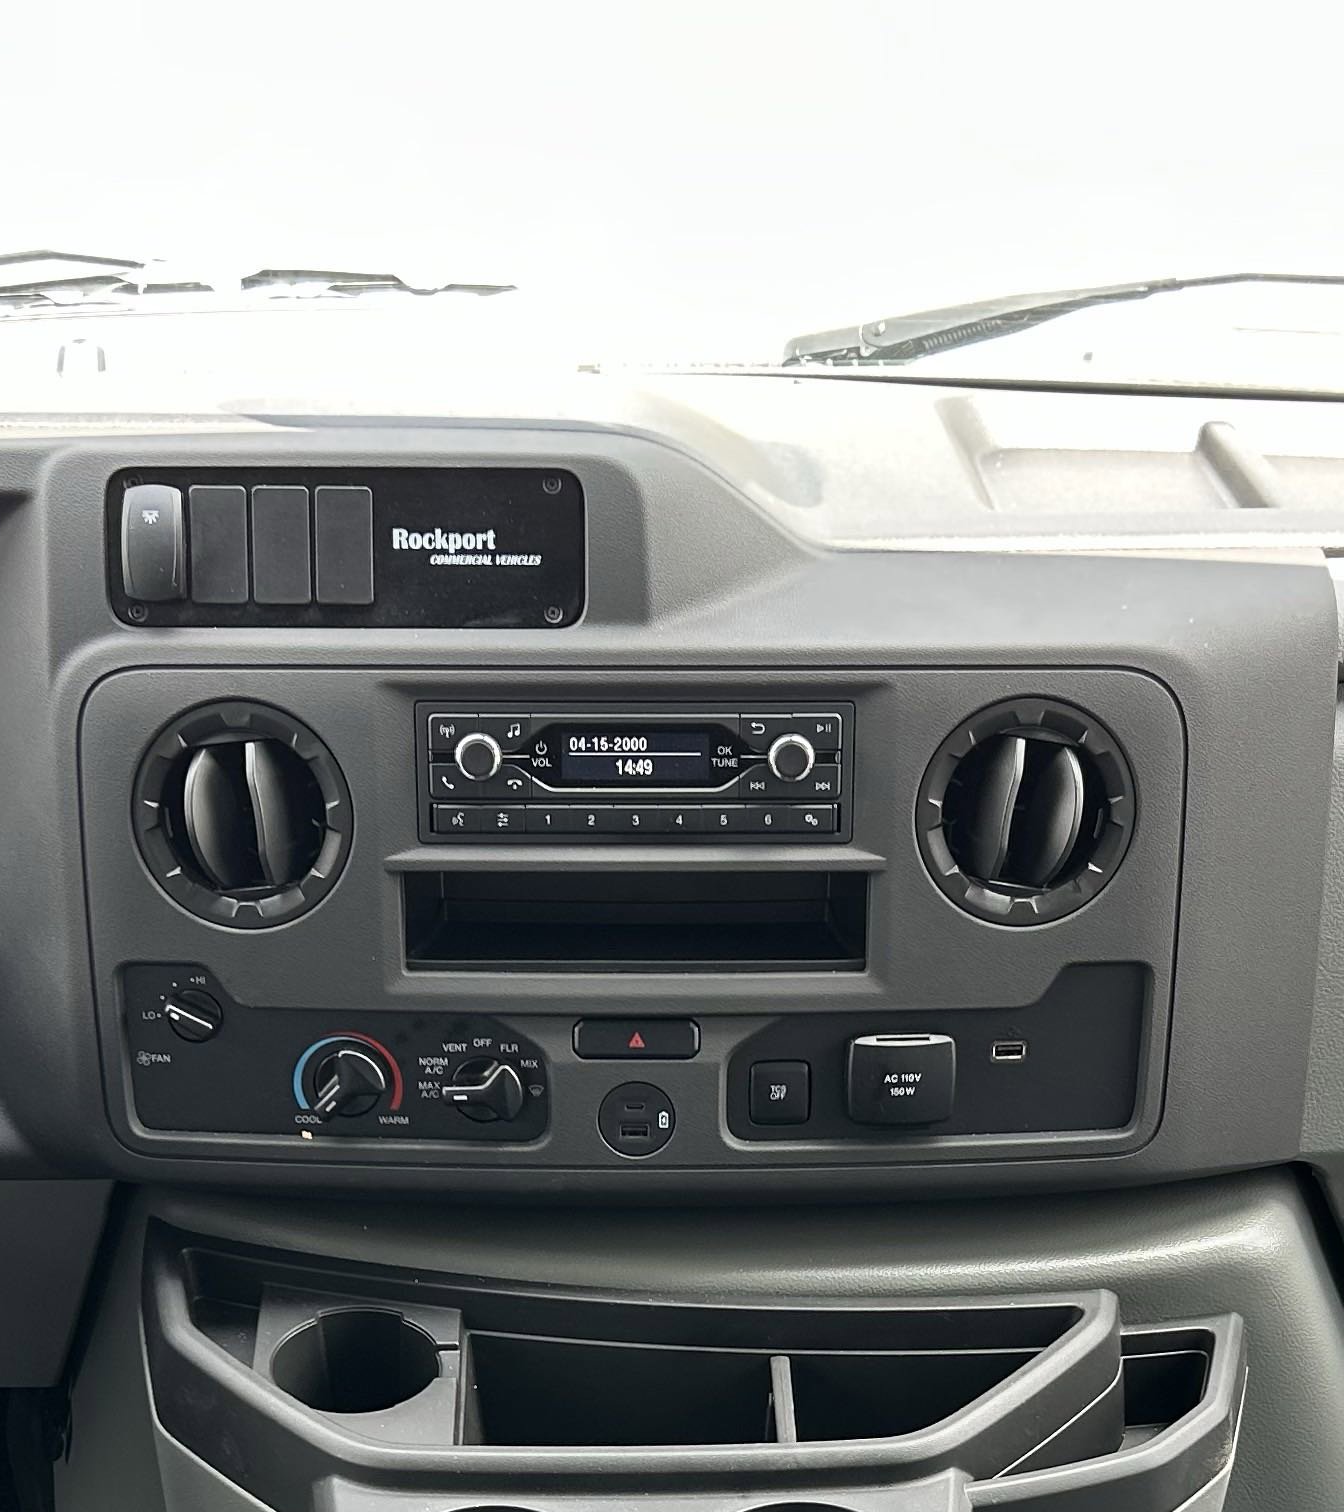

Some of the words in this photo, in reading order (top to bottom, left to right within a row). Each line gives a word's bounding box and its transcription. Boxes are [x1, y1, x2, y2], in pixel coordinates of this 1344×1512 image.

[392, 527, 496, 554] Rockport
[430, 554, 493, 566] COMMERCIAL
[496, 554, 542, 566] VEHICLES
[569, 736, 648, 751] 04-15-2000
[717, 745, 733, 756] OK
[531, 758, 553, 768] VOL
[615, 759, 654, 776] 14:49
[711, 758, 738, 768] TUNE
[544, 815, 551, 825] 1
[587, 815, 596, 826] 2
[631, 815, 640, 826] 3
[675, 815, 684, 825] 4
[720, 815, 728, 826] 5
[764, 814, 772, 826] 6
[195, 976, 206, 984] HI
[142, 1011, 156, 1020] LO
[442, 1043, 467, 1053] VENT
[473, 1038, 492, 1048] OFF
[500, 1044, 518, 1053] FLR
[151, 1053, 171, 1063] FAN
[418, 1057, 448, 1067] NORM
[520, 1059, 538, 1069] MIX
[425, 1066, 444, 1076] A/C
[884, 1074, 898, 1084] AC
[901, 1073, 922, 1083] 110V
[418, 1081, 440, 1091] MAX
[421, 1089, 440, 1099] A/C
[295, 1114, 323, 1124] COOL
[379, 1115, 409, 1125] WARM
